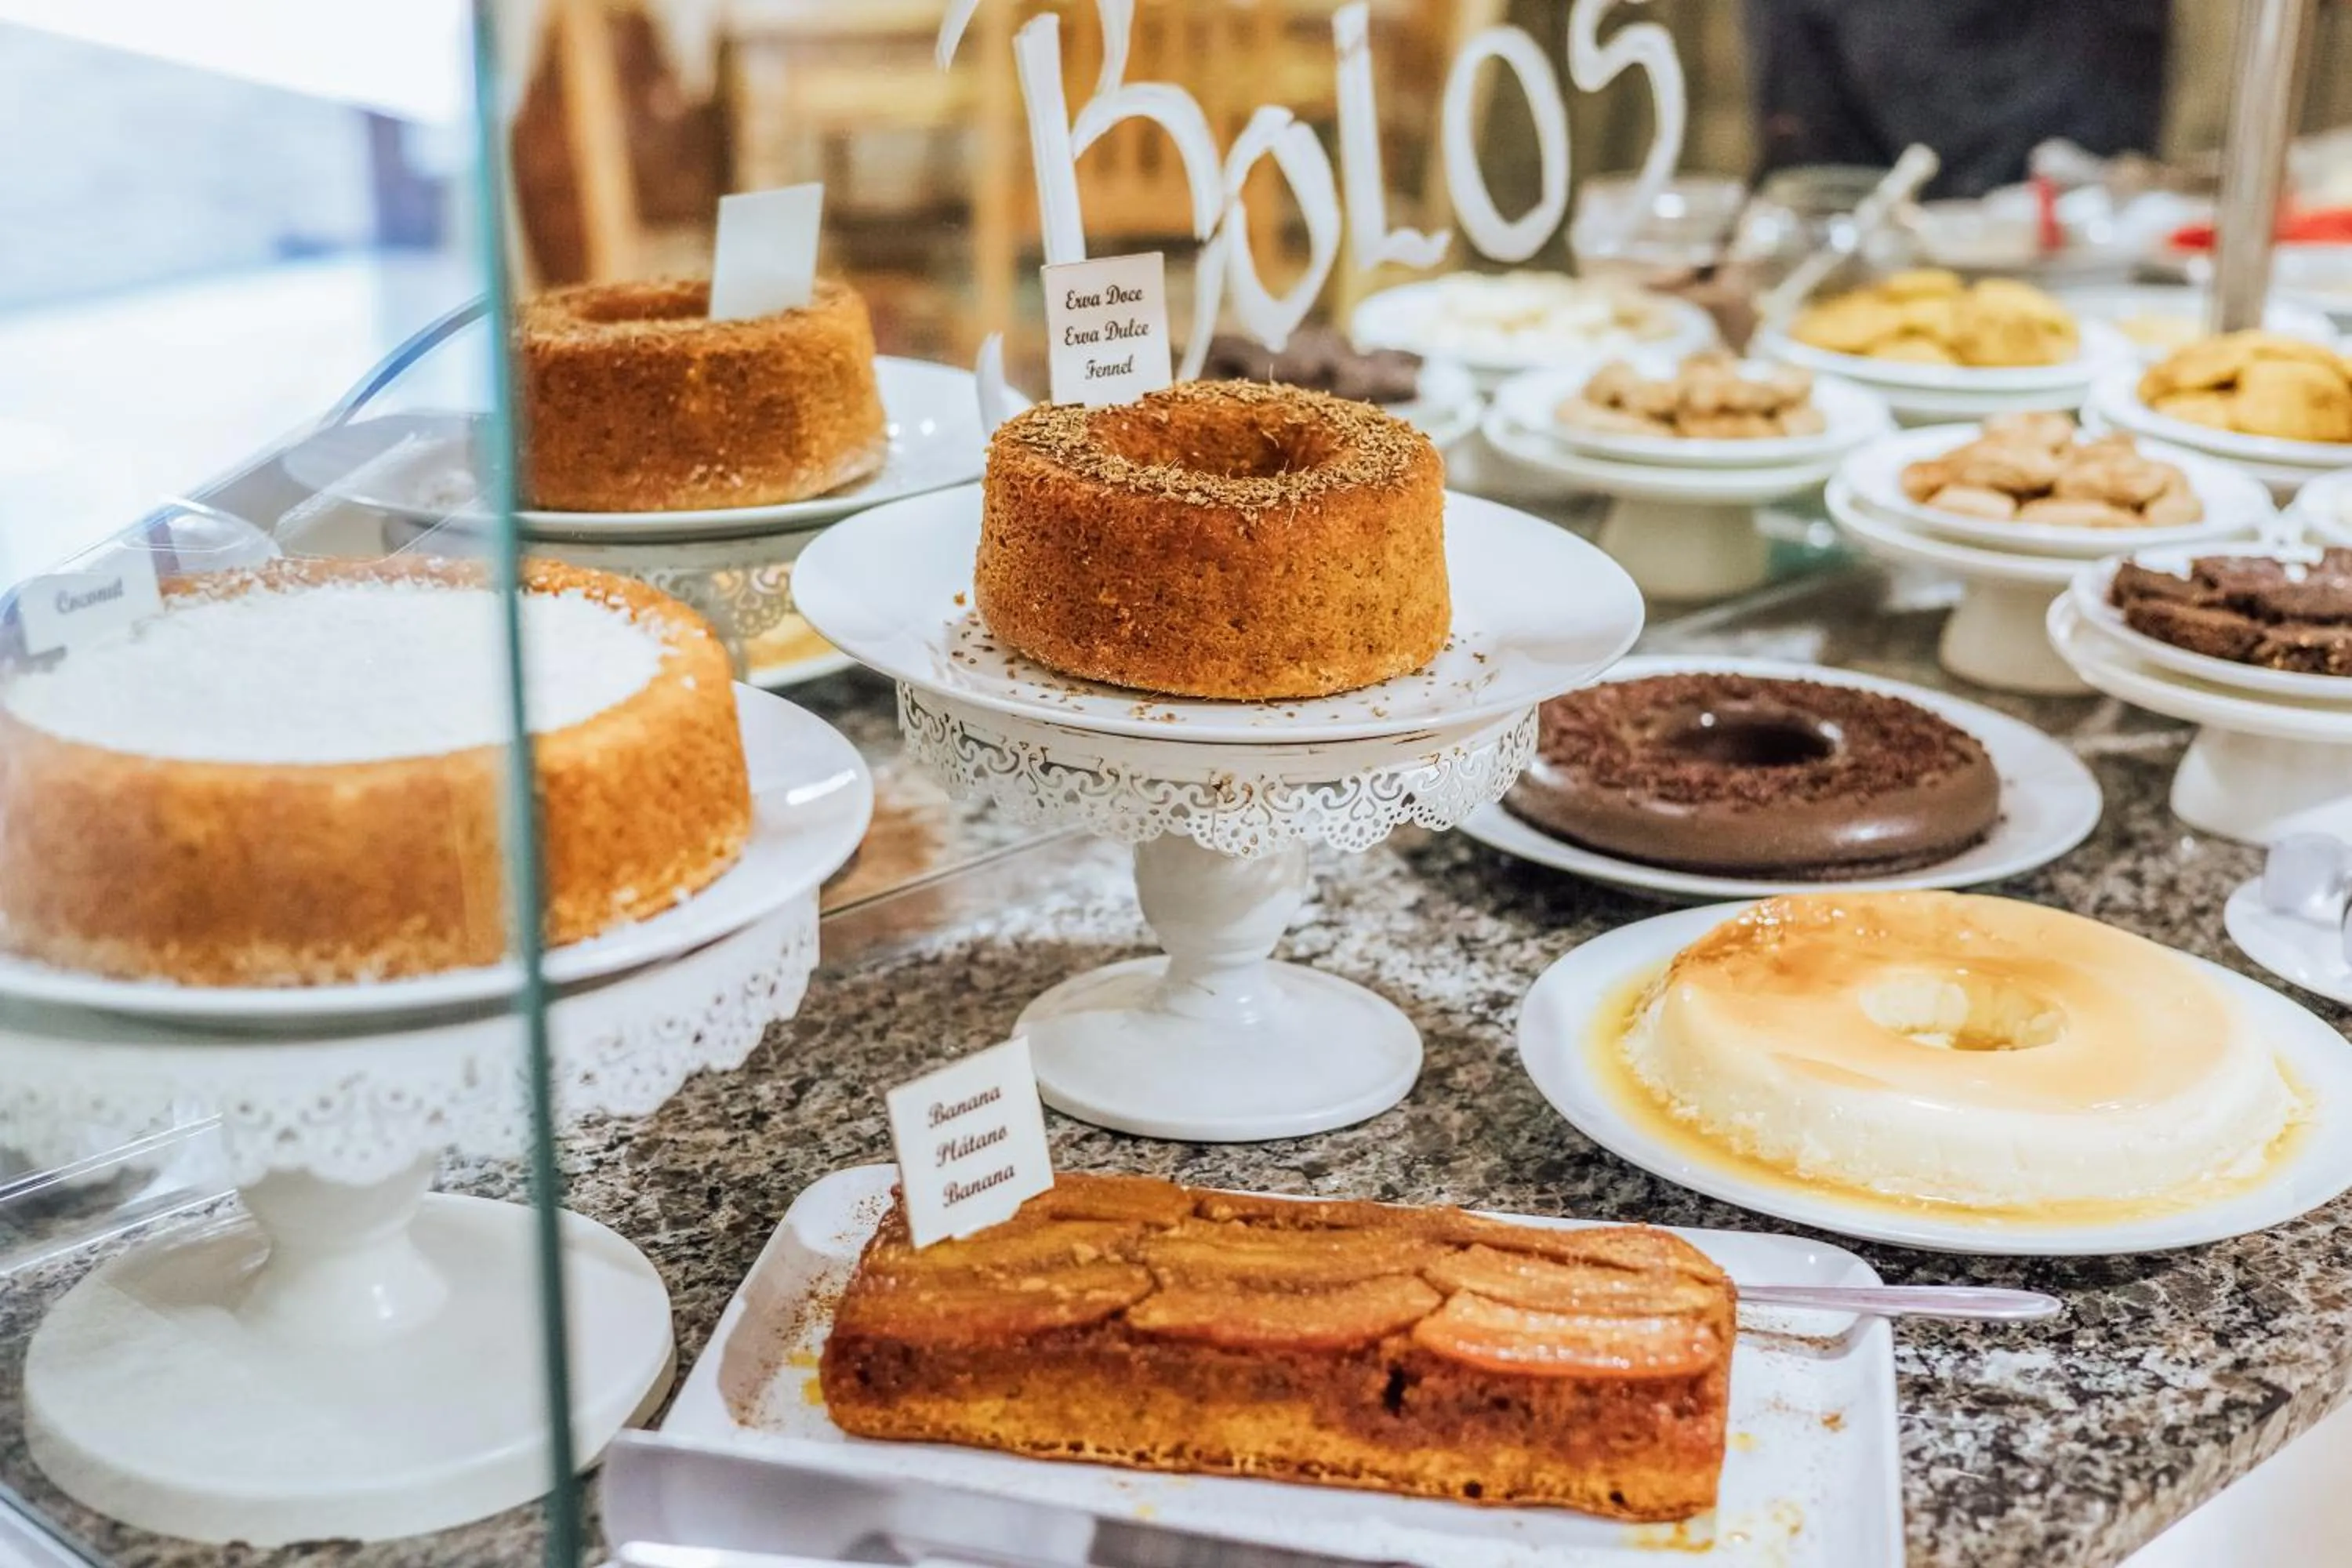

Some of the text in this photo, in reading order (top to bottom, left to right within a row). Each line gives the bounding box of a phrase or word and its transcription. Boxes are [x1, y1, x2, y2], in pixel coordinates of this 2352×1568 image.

[1065, 284, 1145, 310] Erva Doce
[1064, 317, 1151, 347] Erva Dulce
[1084, 354, 1135, 380] Fennel
[927, 1086, 1003, 1129] Banana
[935, 1125, 1008, 1168] Plátano
[942, 1164, 1017, 1208] Banana
